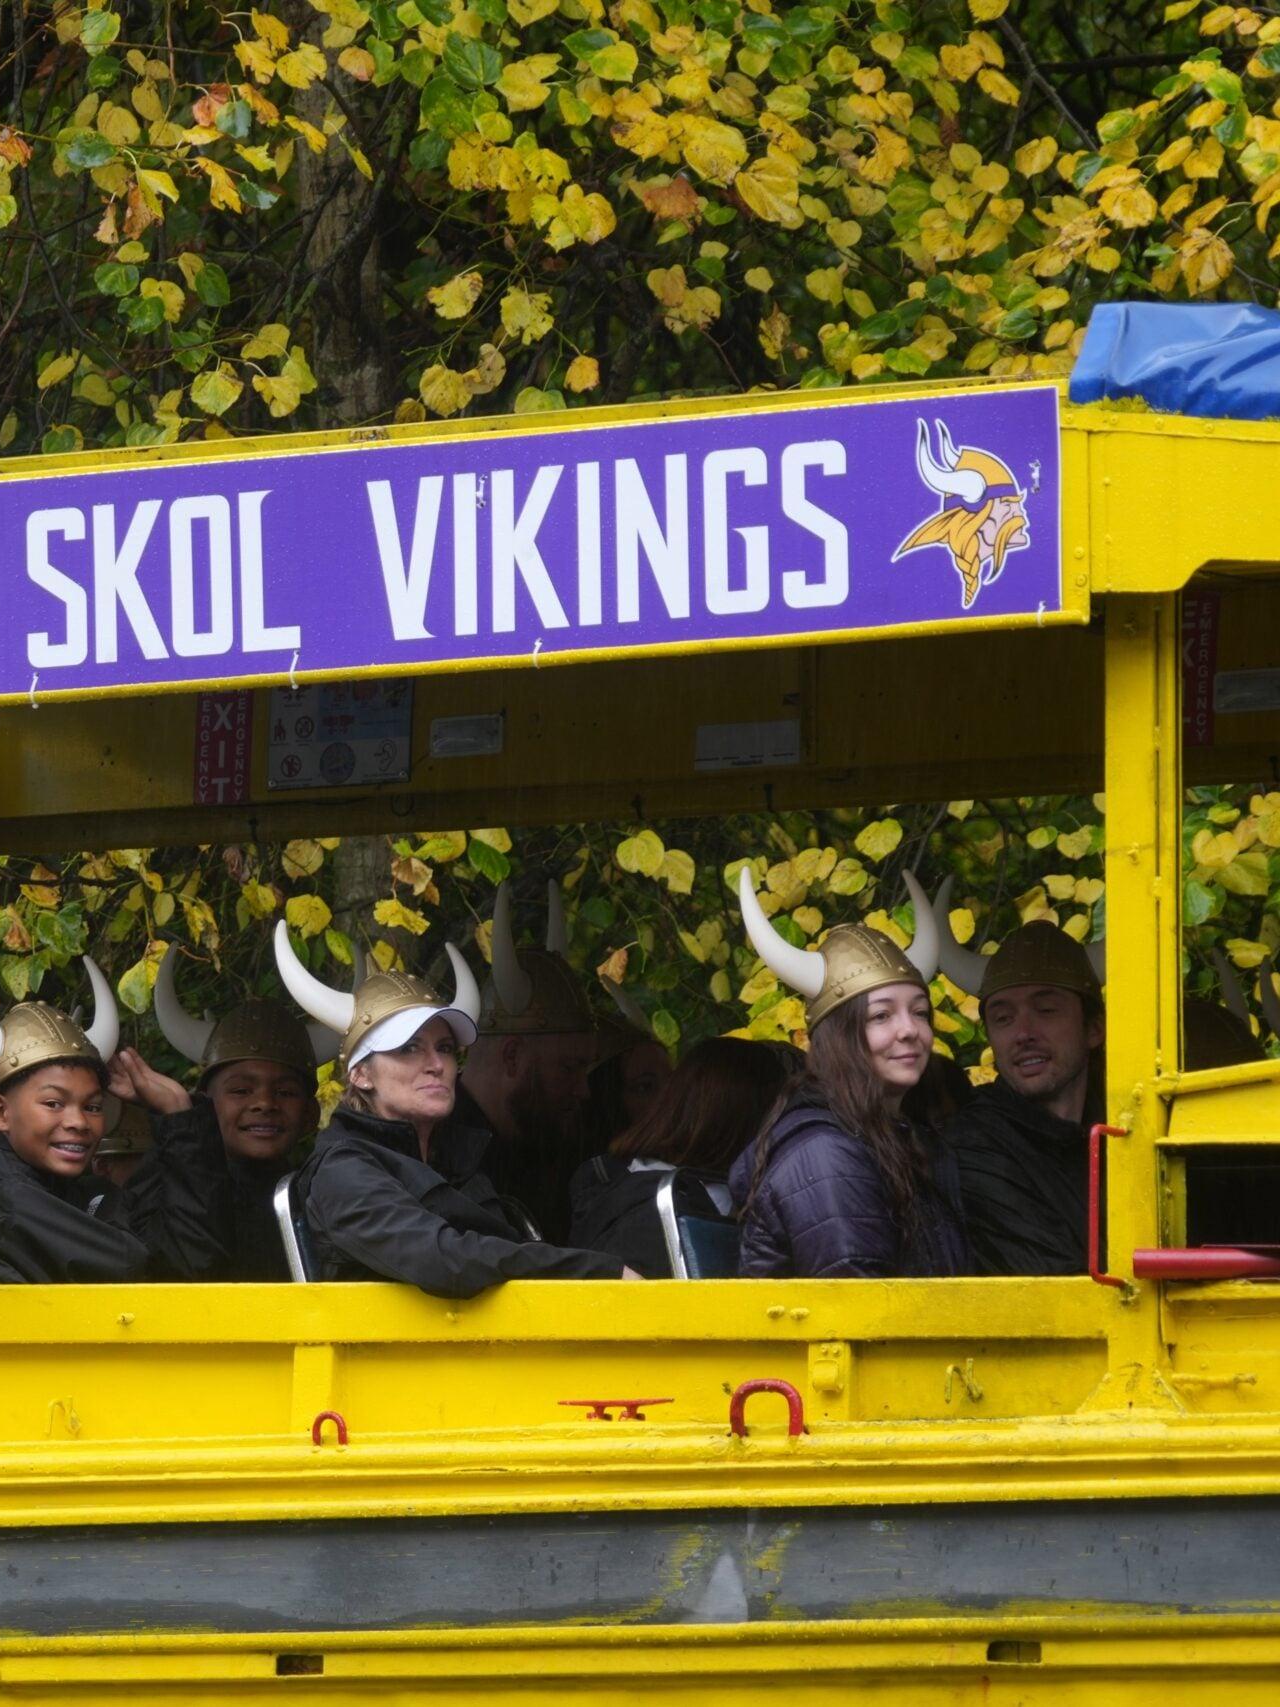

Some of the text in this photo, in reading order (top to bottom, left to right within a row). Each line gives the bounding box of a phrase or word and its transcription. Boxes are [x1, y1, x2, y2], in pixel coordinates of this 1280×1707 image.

[26, 439, 850, 669] SKOL VIKINGS
[1195, 602, 1212, 743] EMERGENCY
[211, 691, 233, 804] XIT
